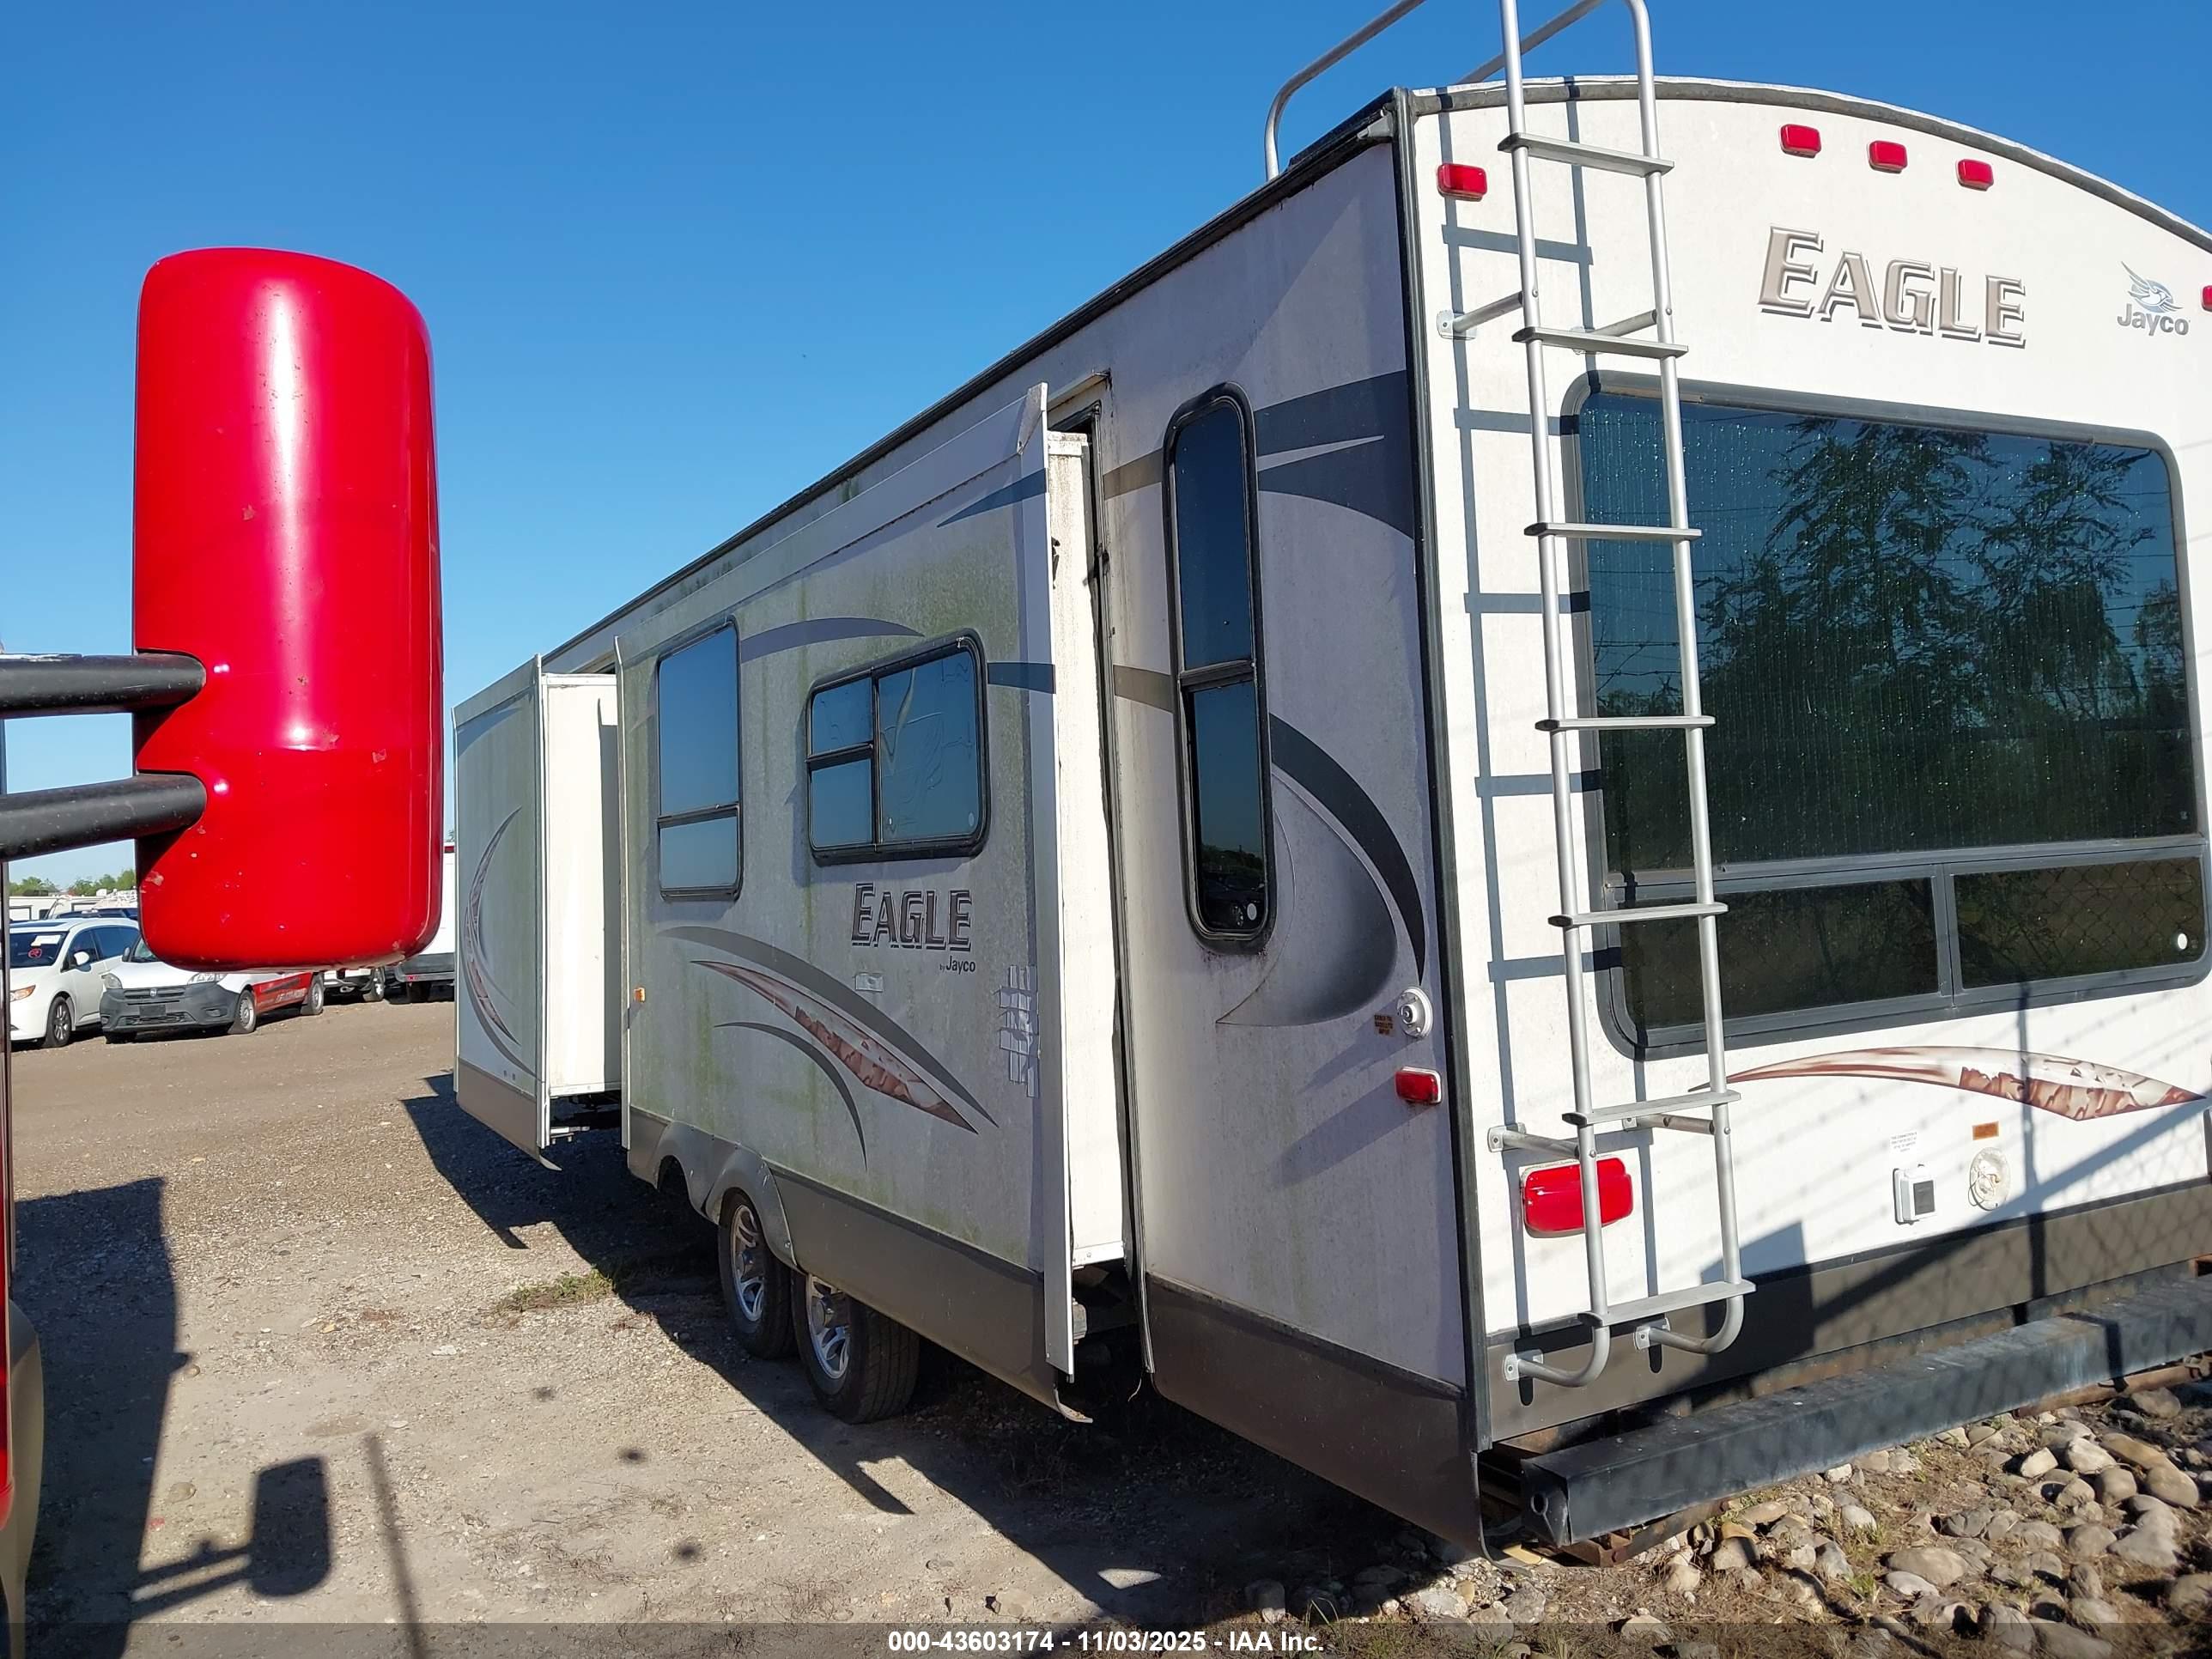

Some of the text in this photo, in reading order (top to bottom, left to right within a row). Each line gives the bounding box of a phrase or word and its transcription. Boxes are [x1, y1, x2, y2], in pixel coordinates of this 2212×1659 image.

[1758, 226, 2026, 349] EAGLE
[2117, 303, 2189, 336] Jayco
[852, 882, 972, 951] EAGLE
[945, 955, 975, 975] Jayco
